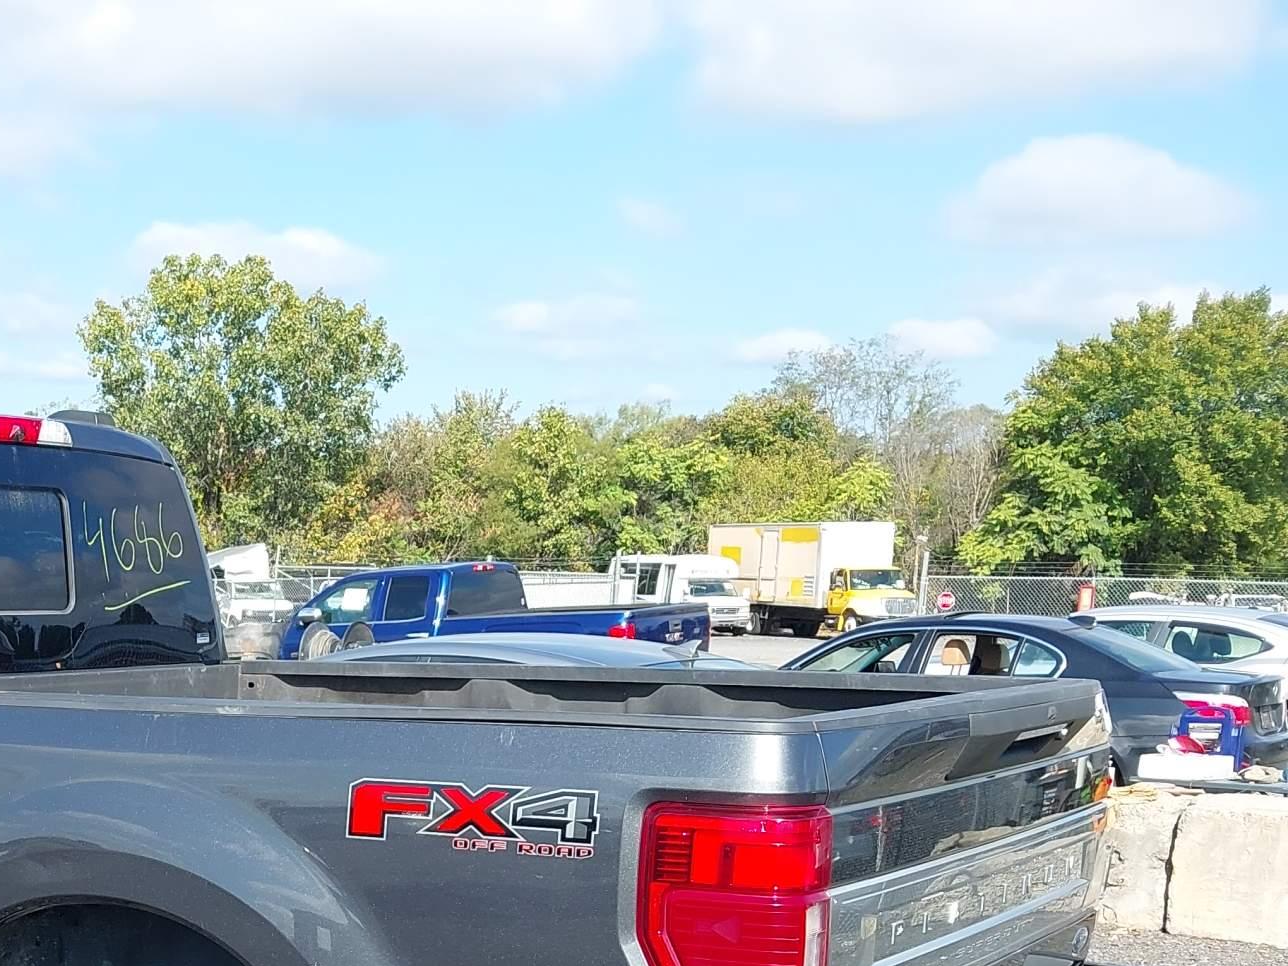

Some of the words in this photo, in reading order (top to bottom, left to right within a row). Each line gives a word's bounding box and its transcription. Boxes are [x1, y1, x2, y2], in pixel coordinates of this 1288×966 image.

[82, 500, 184, 583] 4686
[346, 778, 600, 847] FX4
[452, 838, 508, 852] OFF
[517, 843, 594, 860] ROAD
